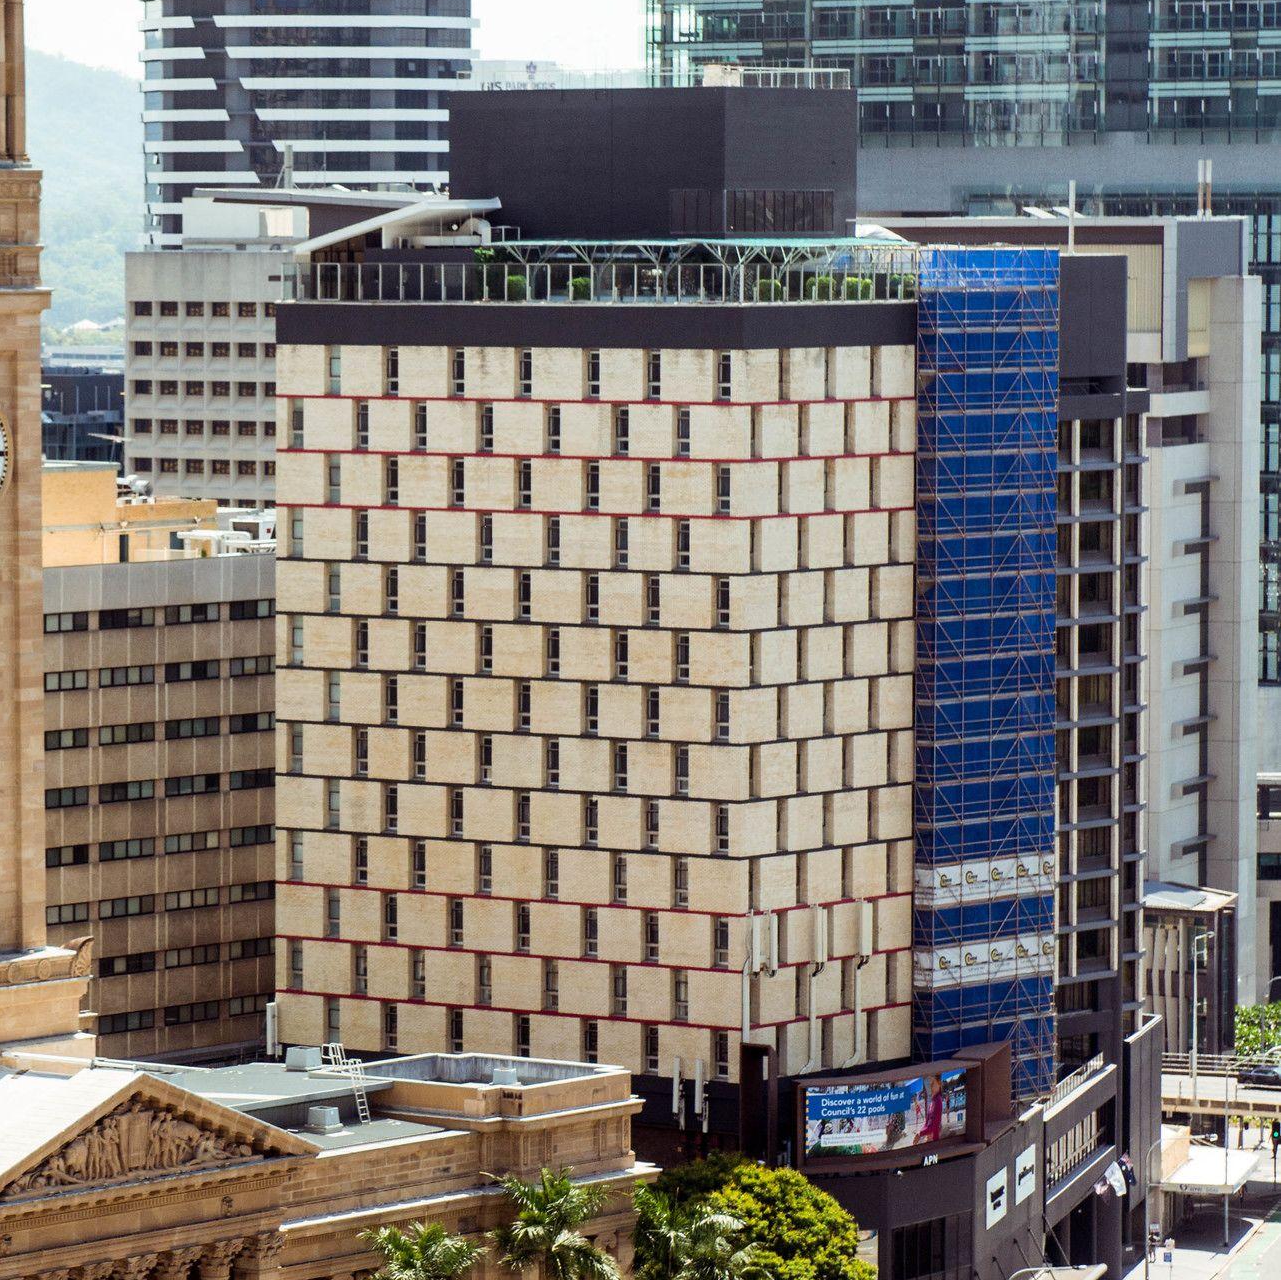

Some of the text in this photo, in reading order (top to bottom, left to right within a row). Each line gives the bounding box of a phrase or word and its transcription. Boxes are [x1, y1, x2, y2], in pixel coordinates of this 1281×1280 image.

[821, 1098, 855, 1107] Discover
[863, 1094, 882, 1104] world
[821, 1104, 886, 1117] Council's 22 pools
[923, 1154, 938, 1166] APN
